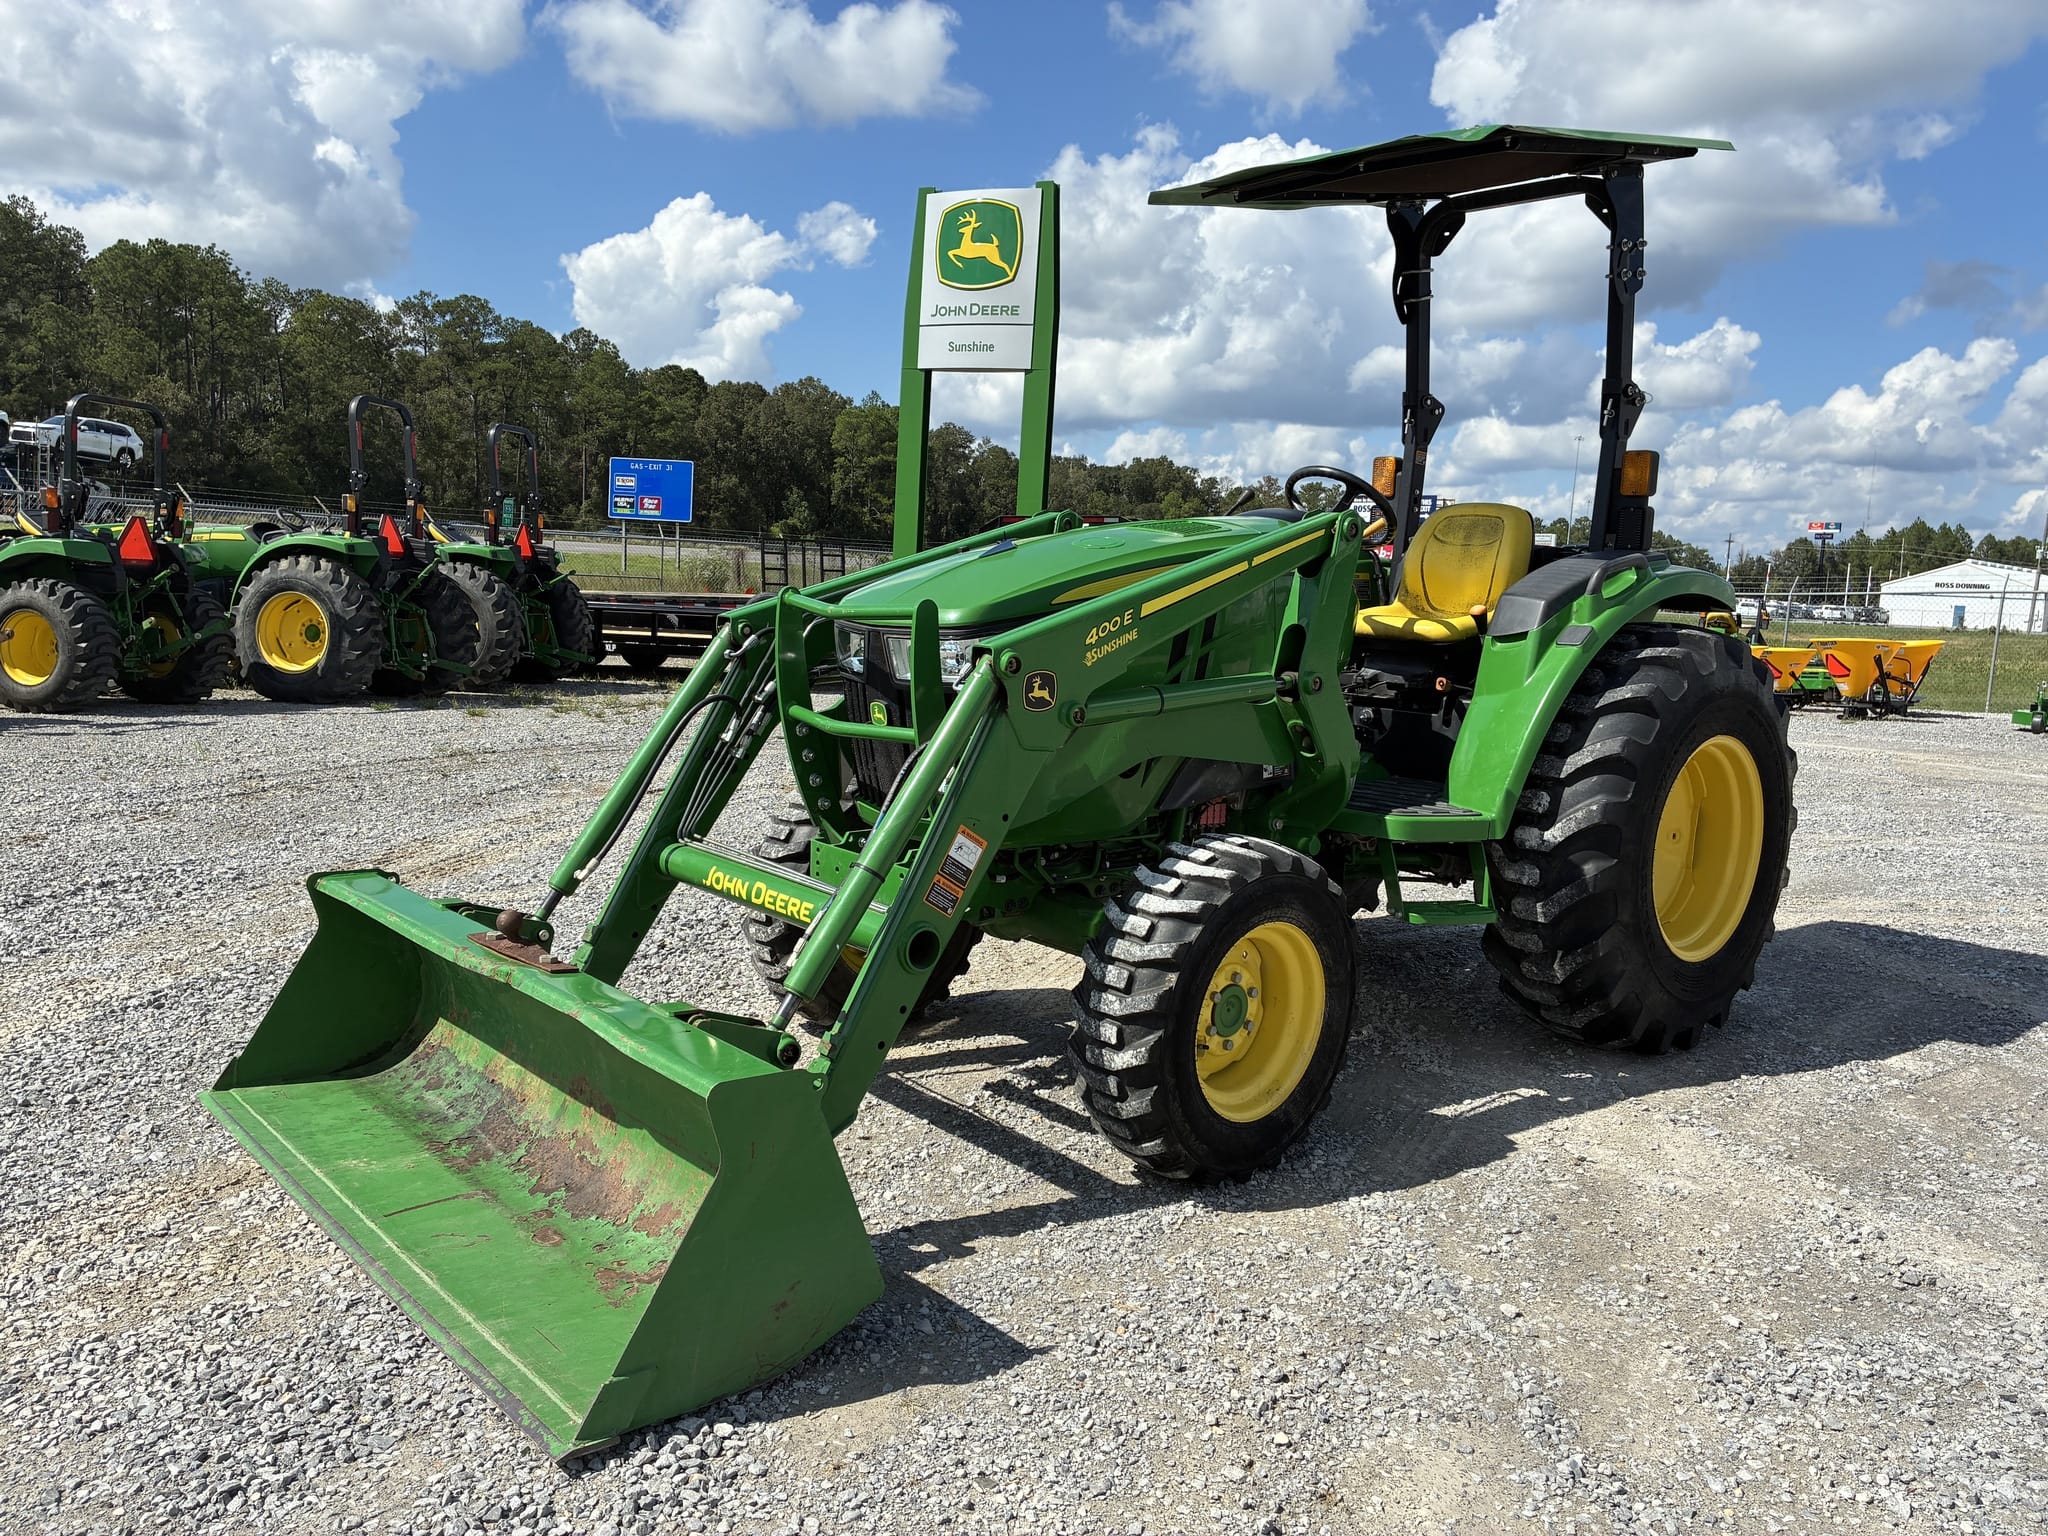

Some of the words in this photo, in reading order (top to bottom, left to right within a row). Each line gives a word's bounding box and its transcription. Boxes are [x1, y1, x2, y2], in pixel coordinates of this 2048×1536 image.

[931, 304, 967, 317] JOHN
[970, 303, 1020, 316] DEERE
[948, 341, 995, 352] Sunshine
[1090, 628, 1138, 663] SUNSHINE
[702, 865, 749, 900] JOHN
[751, 881, 815, 923] DEERE
